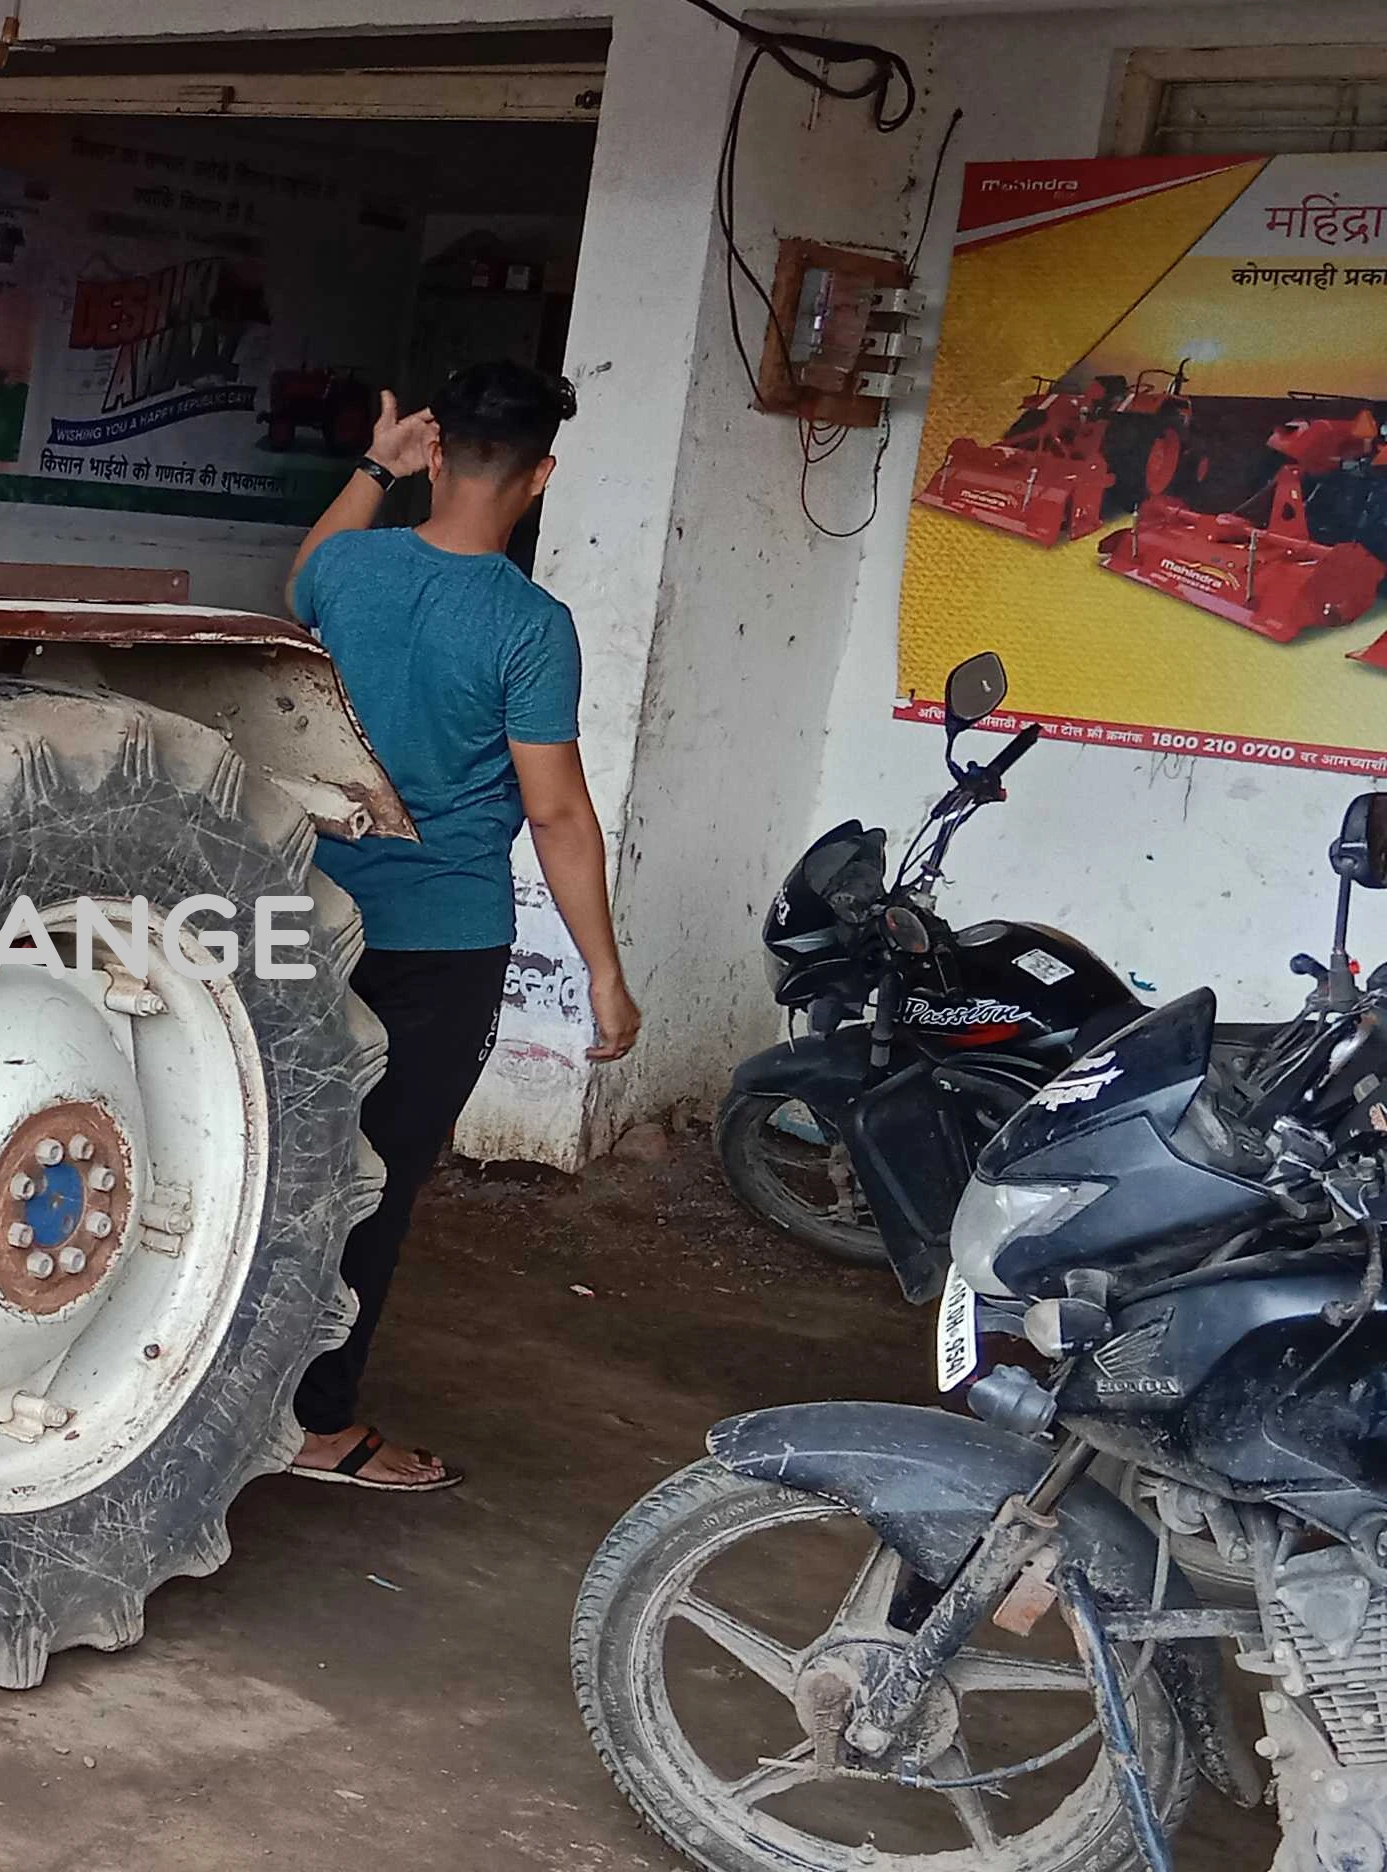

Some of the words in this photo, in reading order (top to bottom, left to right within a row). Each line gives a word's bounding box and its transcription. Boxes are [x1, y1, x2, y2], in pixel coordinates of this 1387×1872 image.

[1232, 261, 1338, 290] कोणत्याही
[56, 427, 102, 442] WISHING
[105, 422, 128, 437] YOU
[129, 420, 138, 430] A
[39, 448, 84, 475] किसान
[132, 457, 151, 481] को
[199, 463, 217, 488] की
[1061, 721, 1083, 738] टोल
[1151, 731, 1199, 750] 1800
[1203, 738, 1237, 754] 210
[1242, 742, 1295, 761] 0700
[1299, 750, 1317, 764] वर
[901, 997, 1032, 1026] Passion
